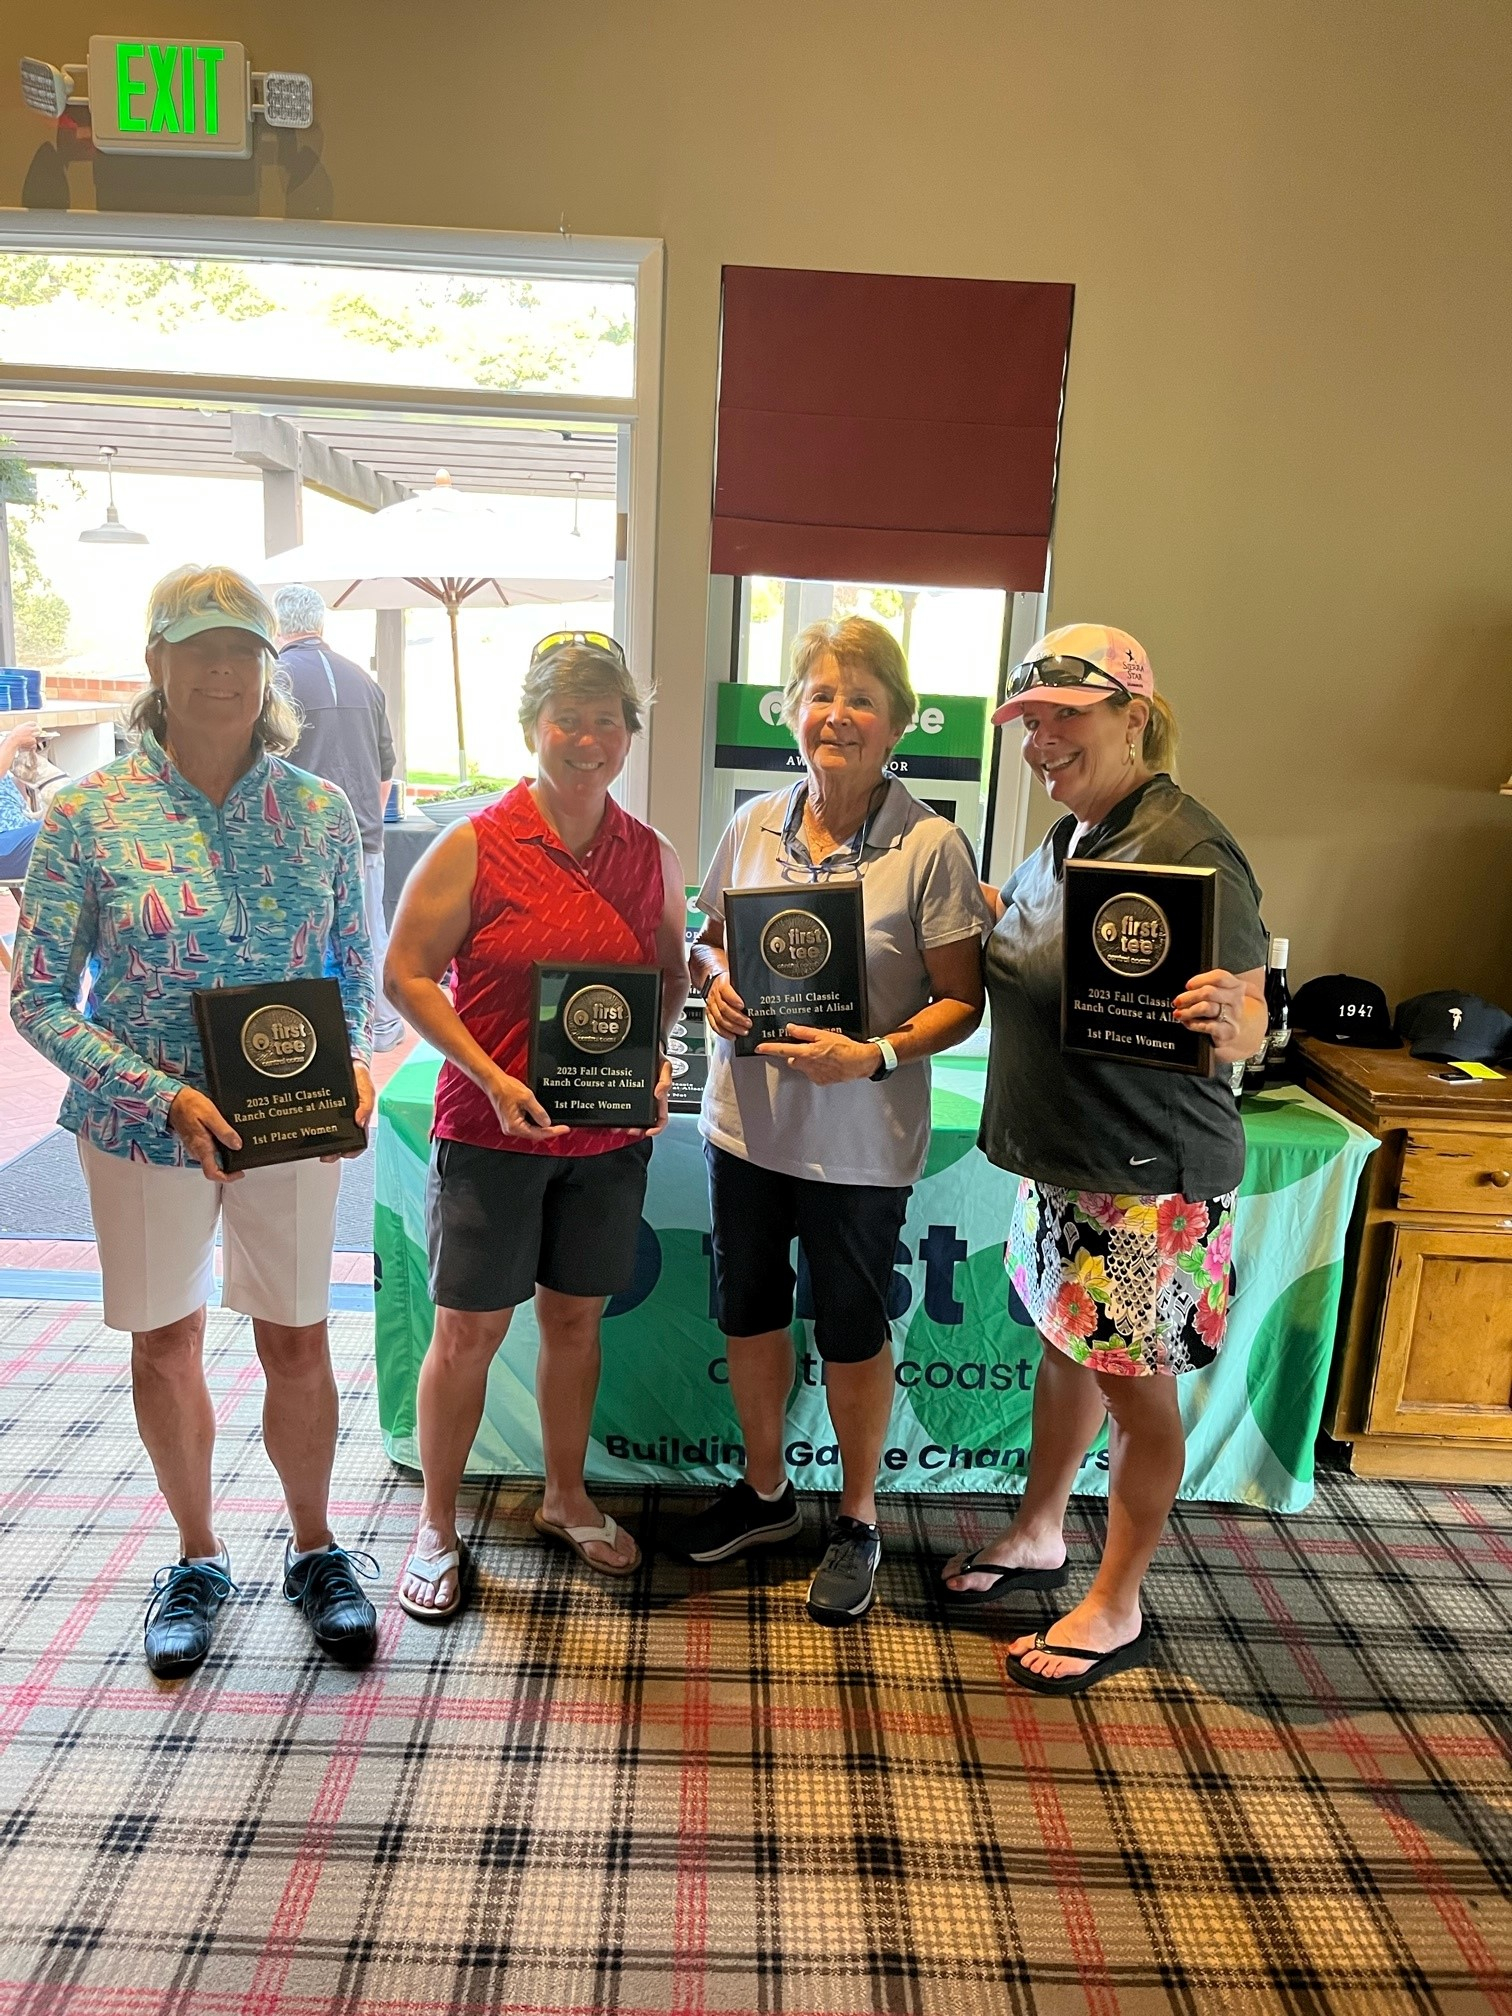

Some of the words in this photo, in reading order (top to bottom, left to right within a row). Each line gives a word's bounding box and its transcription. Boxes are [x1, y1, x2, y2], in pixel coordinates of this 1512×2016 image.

[116, 43, 224, 135] EXIT
[1121, 915, 1159, 937] first
[788, 928, 821, 945] first
[789, 945, 820, 959] tee
[1120, 936, 1153, 955] tee
[760, 995, 781, 1004] 2023
[784, 994, 802, 1003] Fall
[805, 991, 840, 1002] Classic
[1088, 988, 1111, 999] 2023
[1114, 991, 1134, 1004] Fall
[592, 1003, 624, 1019] first
[747, 1007, 776, 1017] Ranch
[779, 1006, 811, 1015] Course
[814, 1004, 823, 1013] at
[826, 1002, 854, 1012] Alisal
[1074, 1000, 1104, 1013] Ranch
[1107, 1004, 1143, 1019] Course
[1146, 1010, 1156, 1020] at
[1339, 1004, 1373, 1017] 1947
[271, 1022, 307, 1039] first
[592, 1020, 619, 1034] tee
[762, 1029, 776, 1038] 1st
[273, 1039, 306, 1055] tee
[1087, 1028, 1101, 1039] 1st
[1105, 1030, 1132, 1044] Place
[1136, 1034, 1176, 1050] Women
[556, 1067, 577, 1075] 2023
[580, 1067, 597, 1075] Fall
[601, 1067, 633, 1076] Classic
[543, 1078, 571, 1087] Ranch
[573, 1078, 605, 1087] Course
[618, 1079, 645, 1088] Alisal
[246, 1097, 270, 1108] 2023
[272, 1093, 292, 1104] Fall
[295, 1088, 331, 1101] Classic
[554, 1100, 568, 1109] 1st
[571, 1100, 595, 1109] Place
[598, 1101, 632, 1109] Women
[234, 1108, 266, 1123] Ranch
[268, 1104, 303, 1117] Course
[306, 1104, 316, 1112] at
[318, 1097, 347, 1110] Alisal
[252, 1135, 268, 1145] 1st
[270, 1131, 298, 1143] Place
[300, 1125, 338, 1138] Women
[895, 1358, 1032, 1391] coast
[605, 1434, 746, 1466] Buildin
[784, 1440, 908, 1471] Gae
[918, 1443, 1110, 1471] Chanrs
